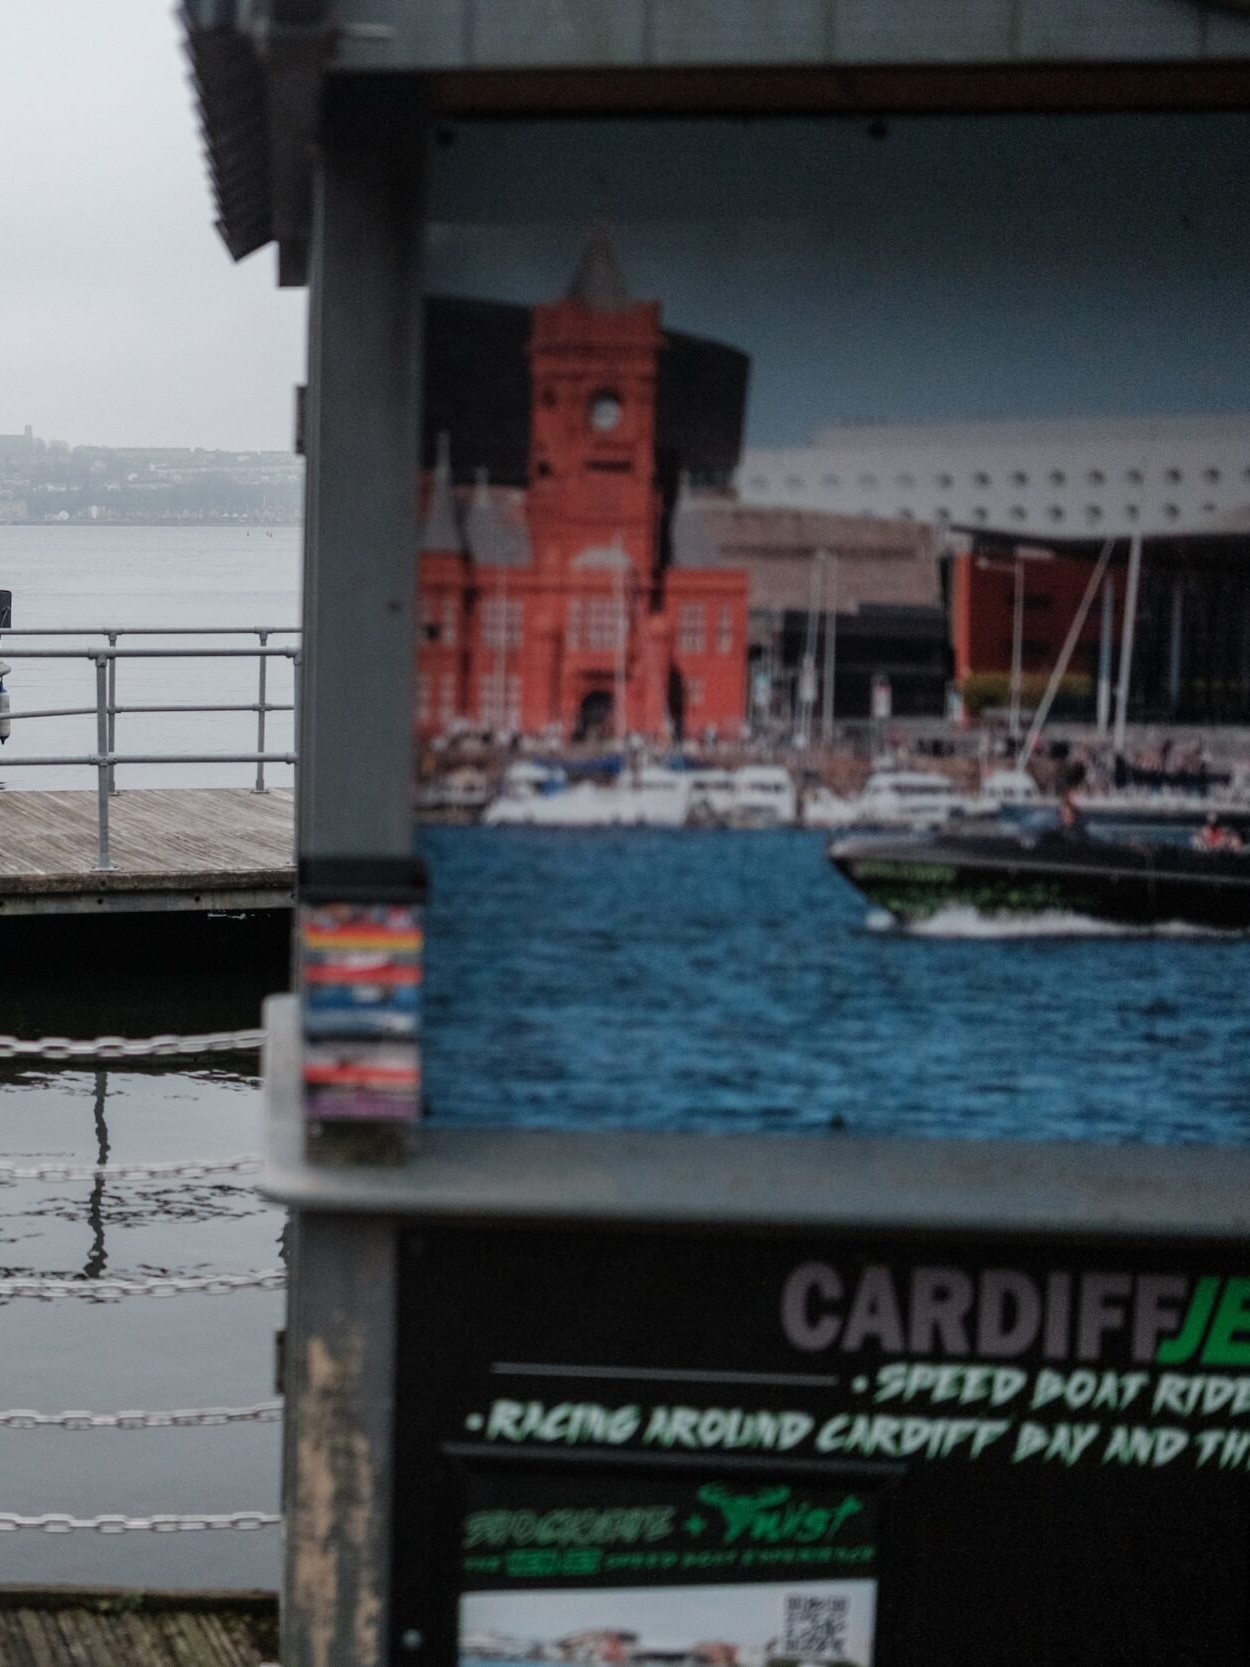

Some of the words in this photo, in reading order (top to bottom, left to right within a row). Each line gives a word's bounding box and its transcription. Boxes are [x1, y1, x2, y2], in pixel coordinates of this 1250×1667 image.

[874, 1362, 1028, 1406] SPEED
[1031, 1368, 1150, 1410] BOAT
[485, 1398, 640, 1445] RACING
[643, 1405, 815, 1452] AROUND
[815, 1412, 1012, 1459] CARDIFF
[1012, 1421, 1099, 1465] BAY
[1102, 1424, 1189, 1467] AND
[1194, 1428, 1250, 1471] TH
